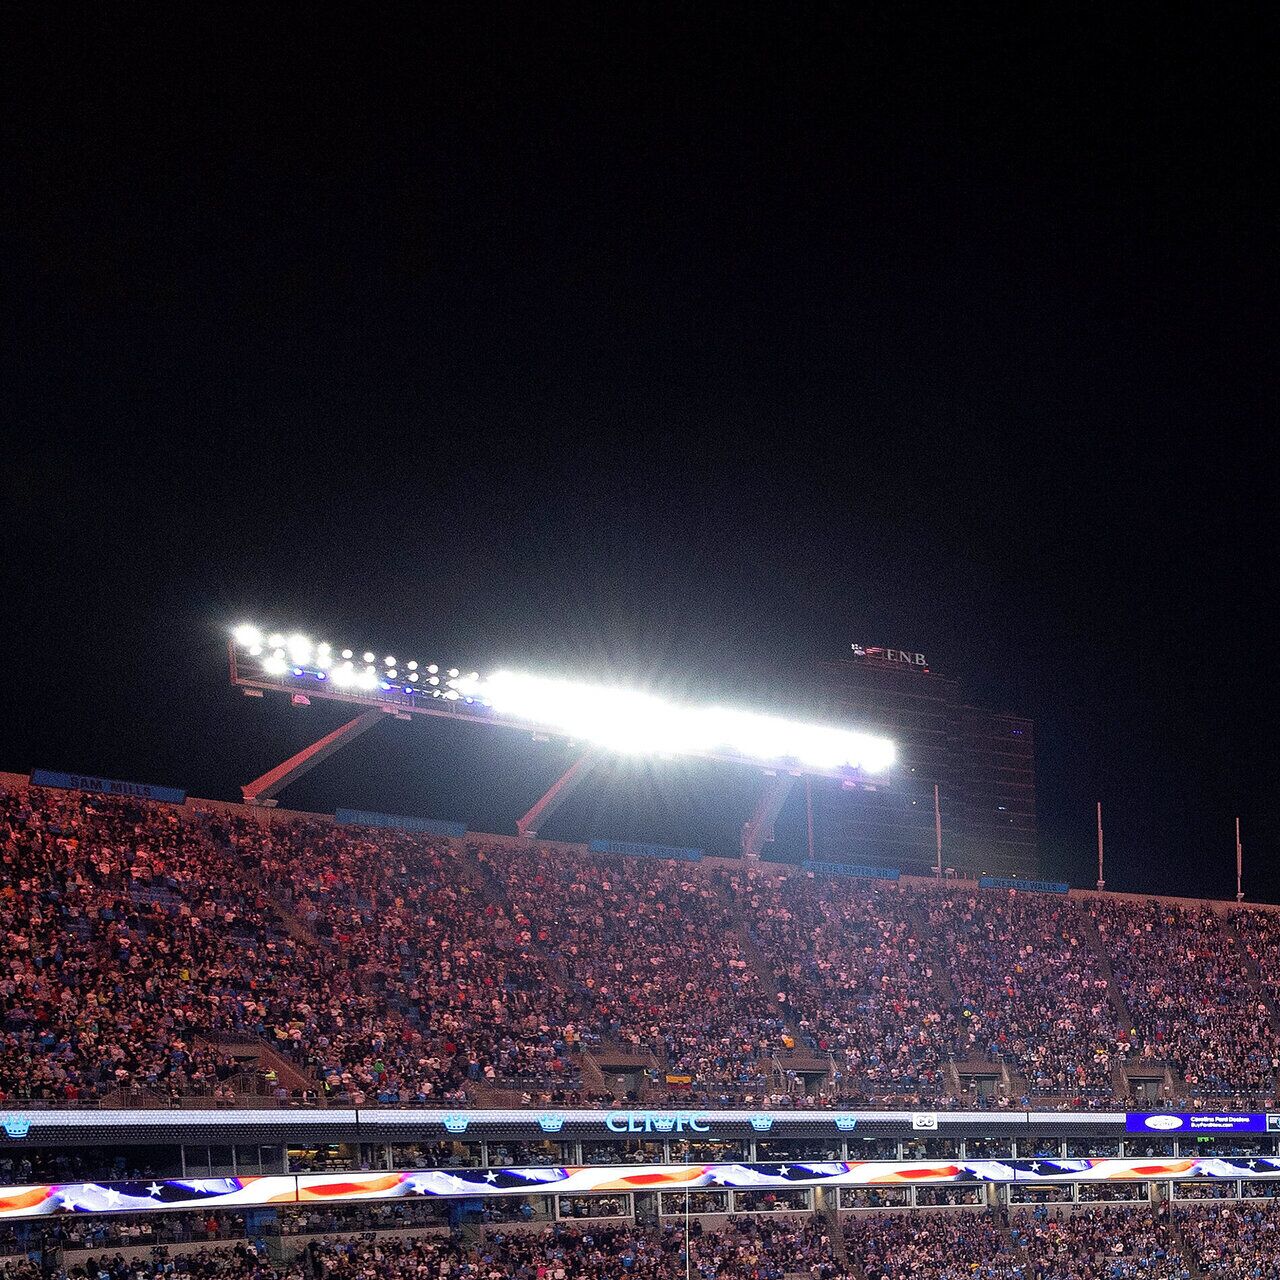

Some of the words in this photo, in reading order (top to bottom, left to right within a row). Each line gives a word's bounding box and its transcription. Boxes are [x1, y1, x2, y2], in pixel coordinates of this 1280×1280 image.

[70, 775, 103, 791] SAM
[110, 781, 152, 797] MILLS
[358, 1232, 377, 1241] 309
